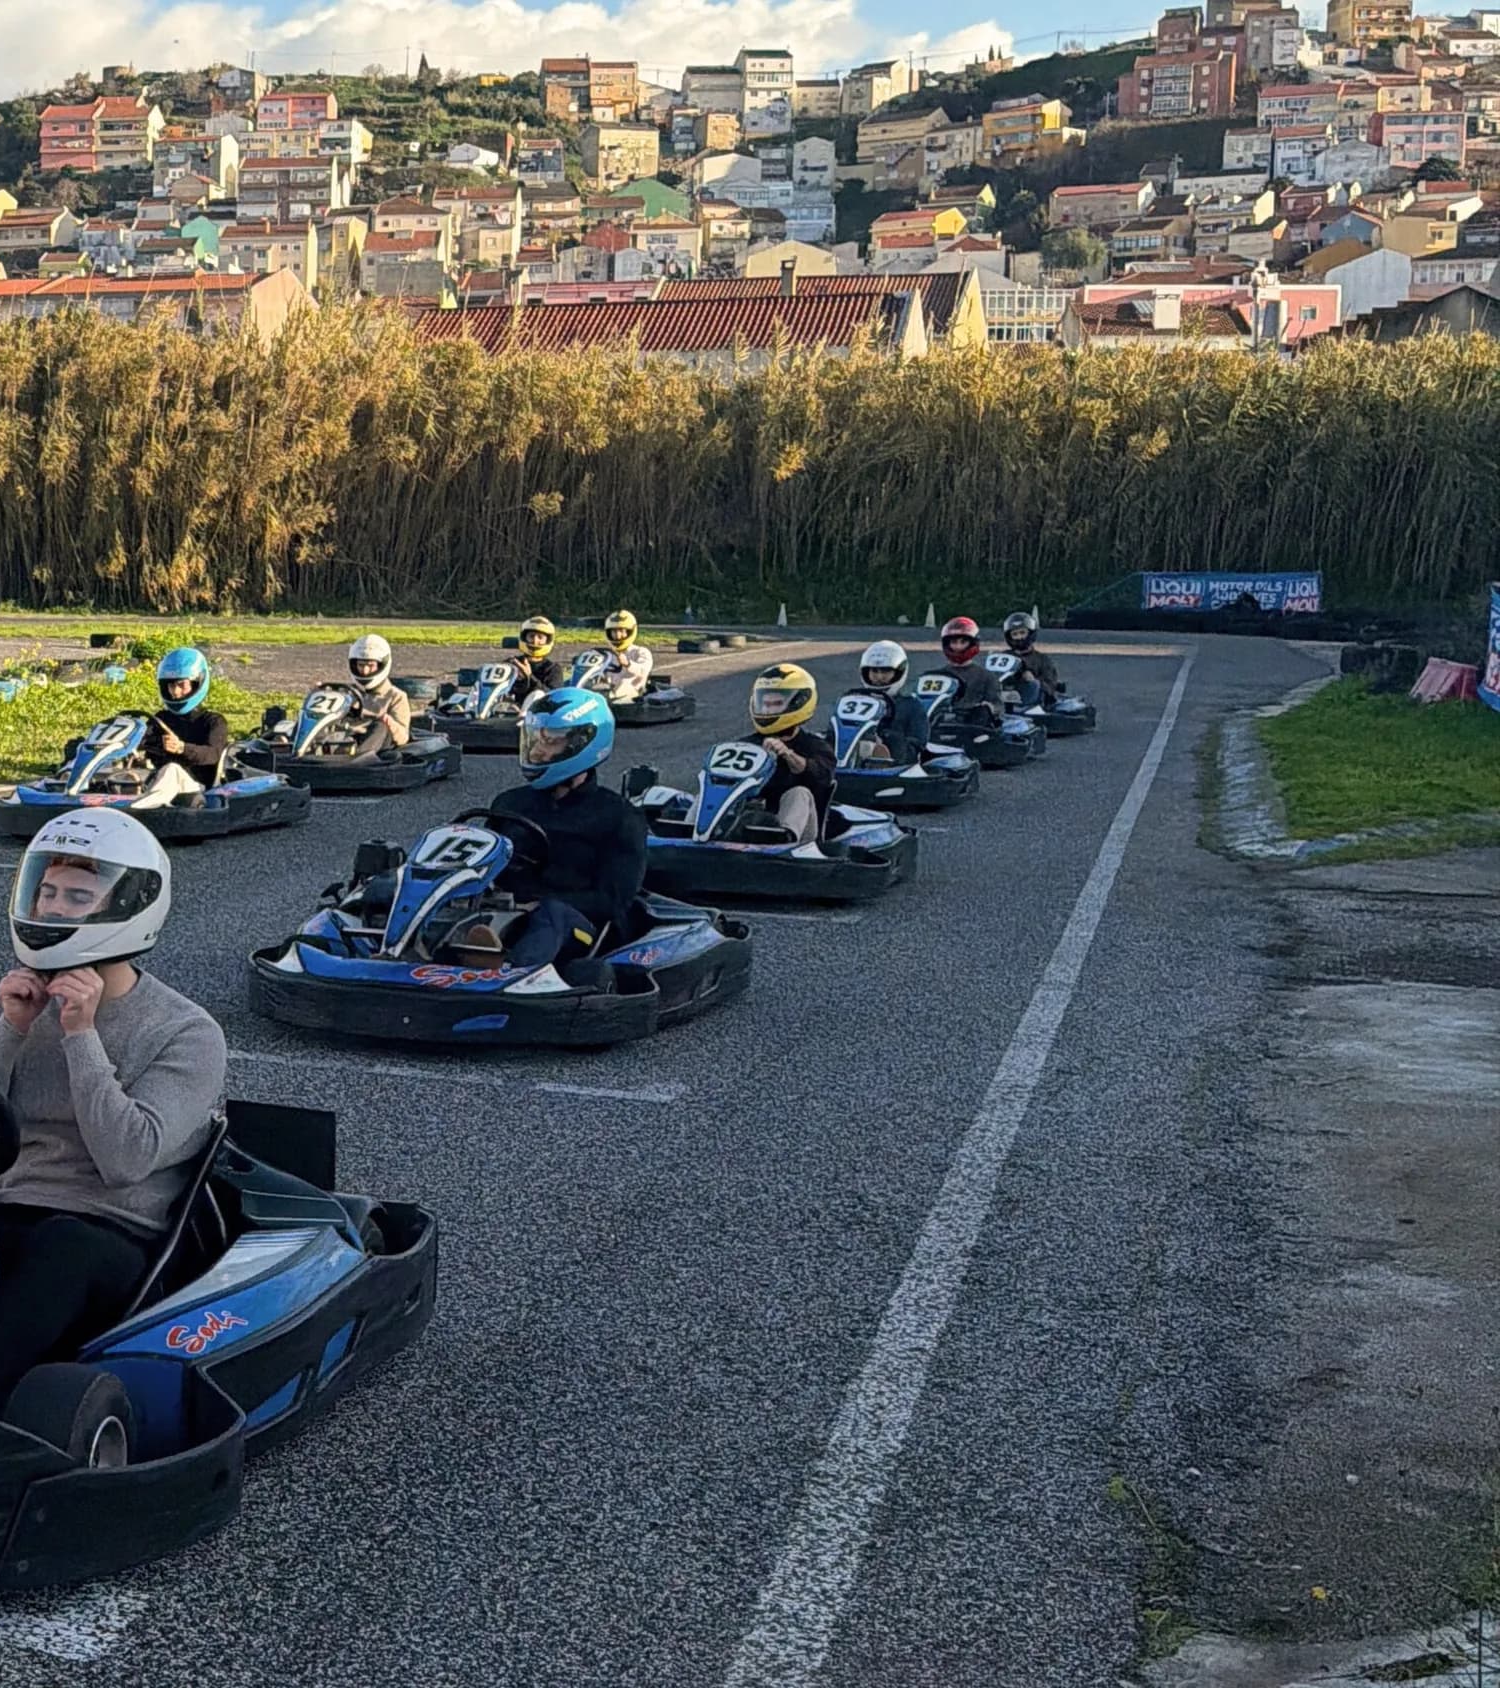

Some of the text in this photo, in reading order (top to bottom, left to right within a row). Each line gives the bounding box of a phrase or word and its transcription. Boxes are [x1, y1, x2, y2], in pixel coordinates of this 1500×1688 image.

[1151, 579, 1201, 594] LIQUI
[1209, 581, 1254, 592] MOTOR
[581, 654, 599, 665] 16
[484, 667, 506, 680] 19
[922, 680, 943, 692] 33
[309, 695, 338, 710] 21
[842, 700, 874, 716] 37
[711, 748, 758, 772] 25
[421, 836, 491, 862] 15
[166, 1310, 249, 1354] Sodi
